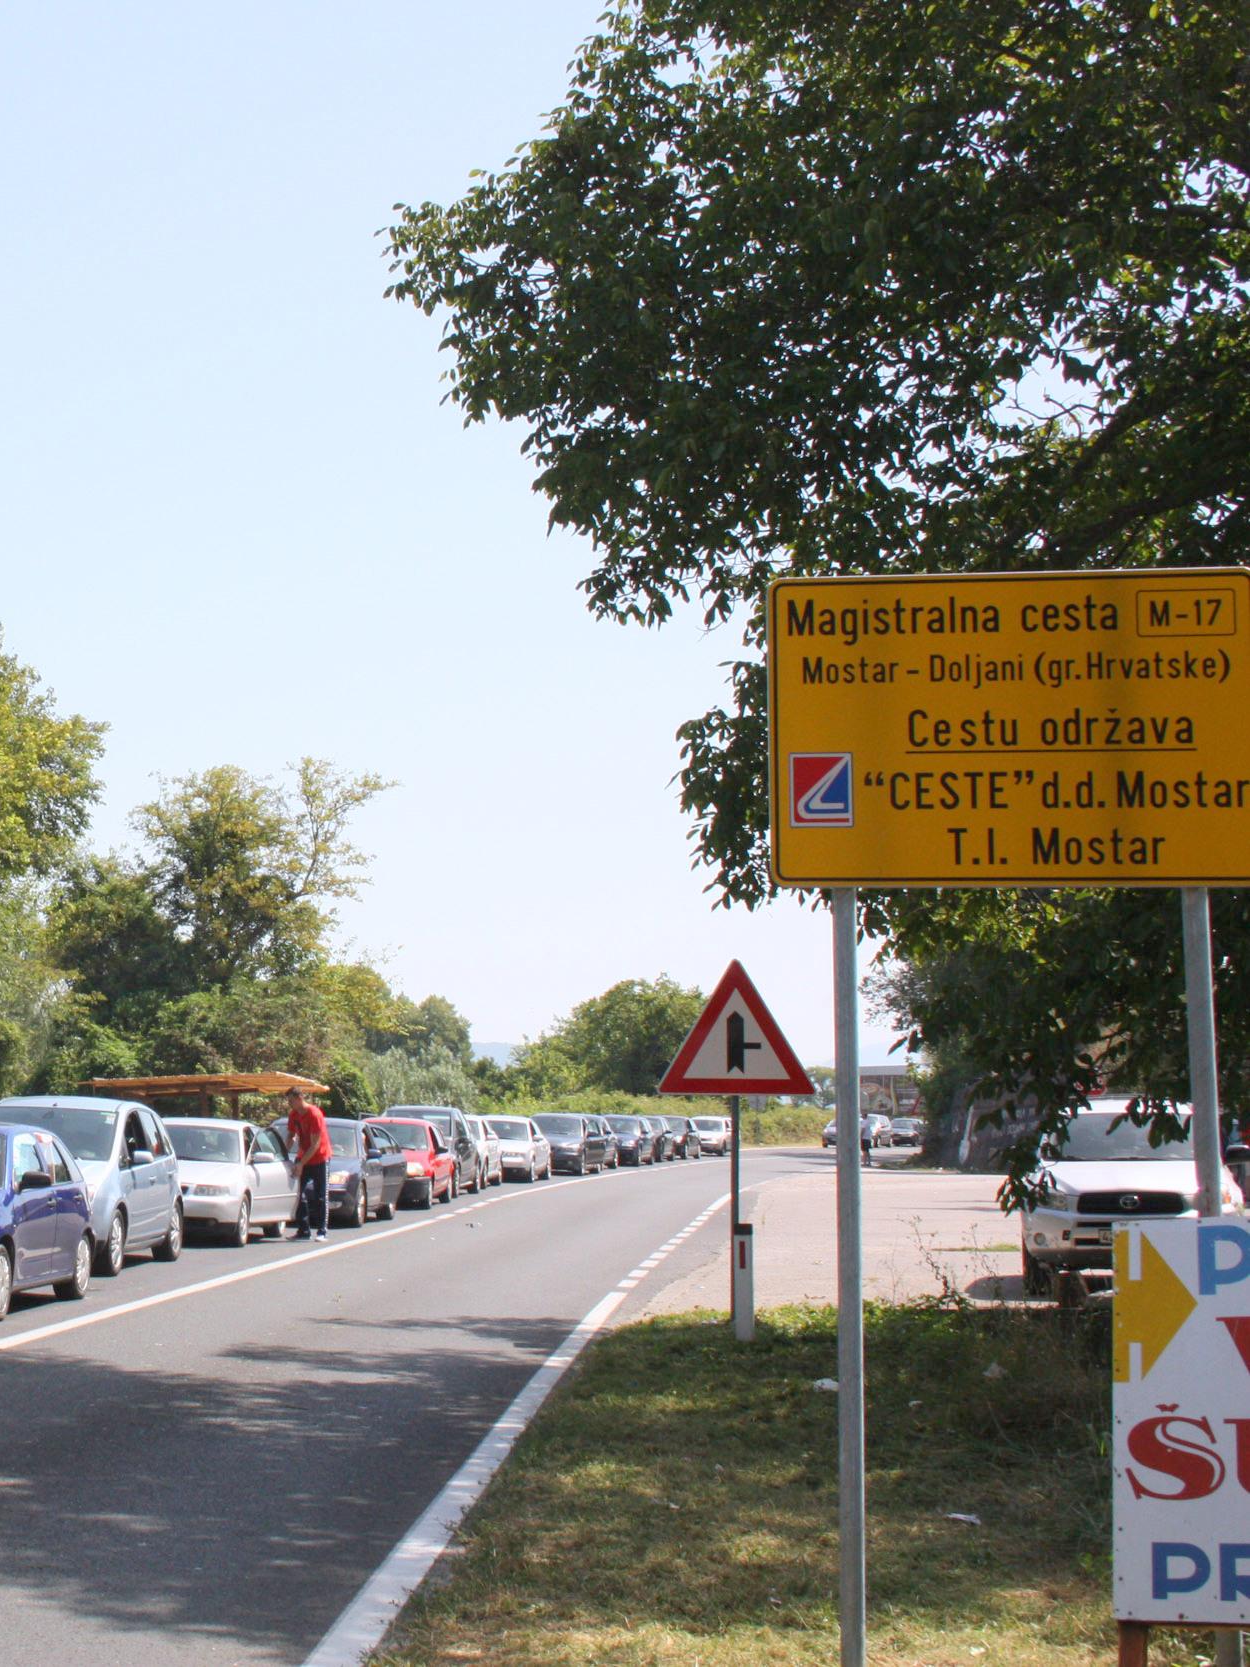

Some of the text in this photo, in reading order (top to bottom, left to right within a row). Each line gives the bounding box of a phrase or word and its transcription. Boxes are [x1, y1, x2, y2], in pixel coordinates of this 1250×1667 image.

[786, 595, 1222, 645] Magistralna cesta M-17
[801, 657, 899, 684] Mostar
[929, 654, 1023, 689] Doljani
[1033, 649, 1231, 688] (gr.Hrvatske)
[907, 708, 1194, 747] Cestu održava
[1041, 771, 1106, 809] d.d.
[1116, 770, 1250, 808] Mostar
[947, 827, 1166, 865] T.I. Mostar
